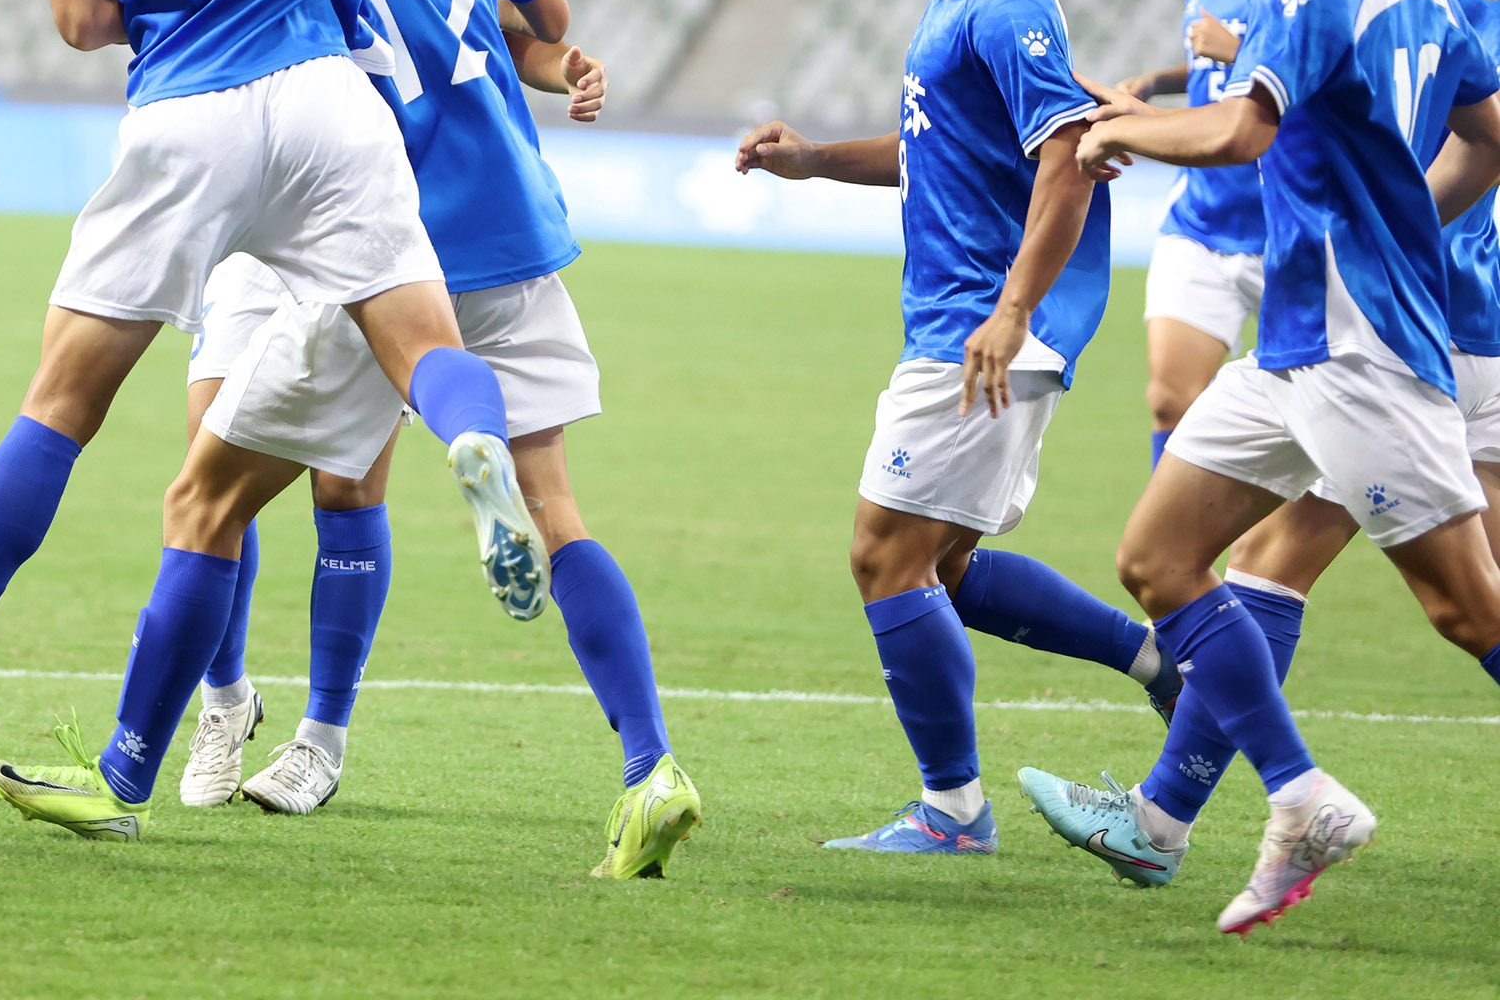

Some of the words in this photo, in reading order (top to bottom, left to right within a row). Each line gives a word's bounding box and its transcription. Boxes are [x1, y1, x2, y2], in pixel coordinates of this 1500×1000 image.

[881, 463, 913, 480] KELME
[1369, 497, 1401, 518] KELME
[320, 556, 376, 571] KELME
[116, 740, 146, 765] KELME
